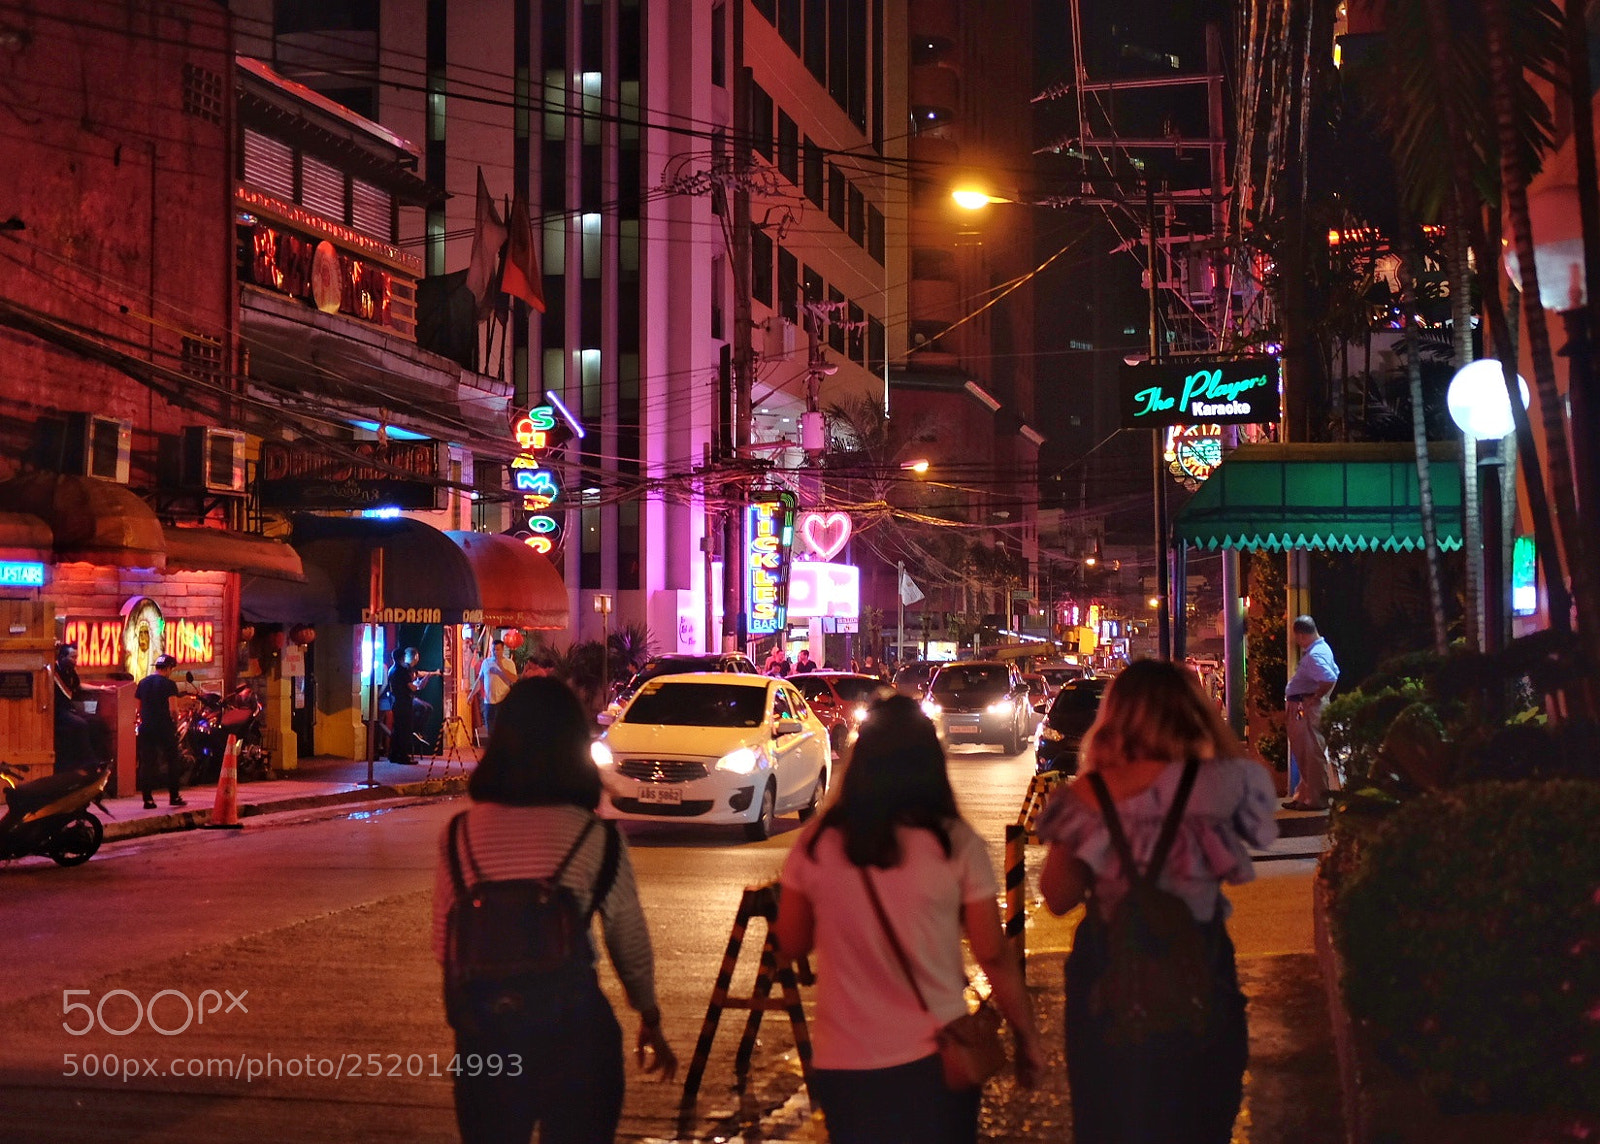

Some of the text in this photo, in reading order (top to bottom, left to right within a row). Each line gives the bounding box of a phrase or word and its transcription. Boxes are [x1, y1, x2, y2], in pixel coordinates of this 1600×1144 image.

[1133, 368, 1268, 417] The Players
[1192, 400, 1252, 416] Karaoke
[750, 501, 780, 620] TICKLES
[65, 619, 214, 667] CRAZY HORSE
[753, 619, 778, 631] BAR
